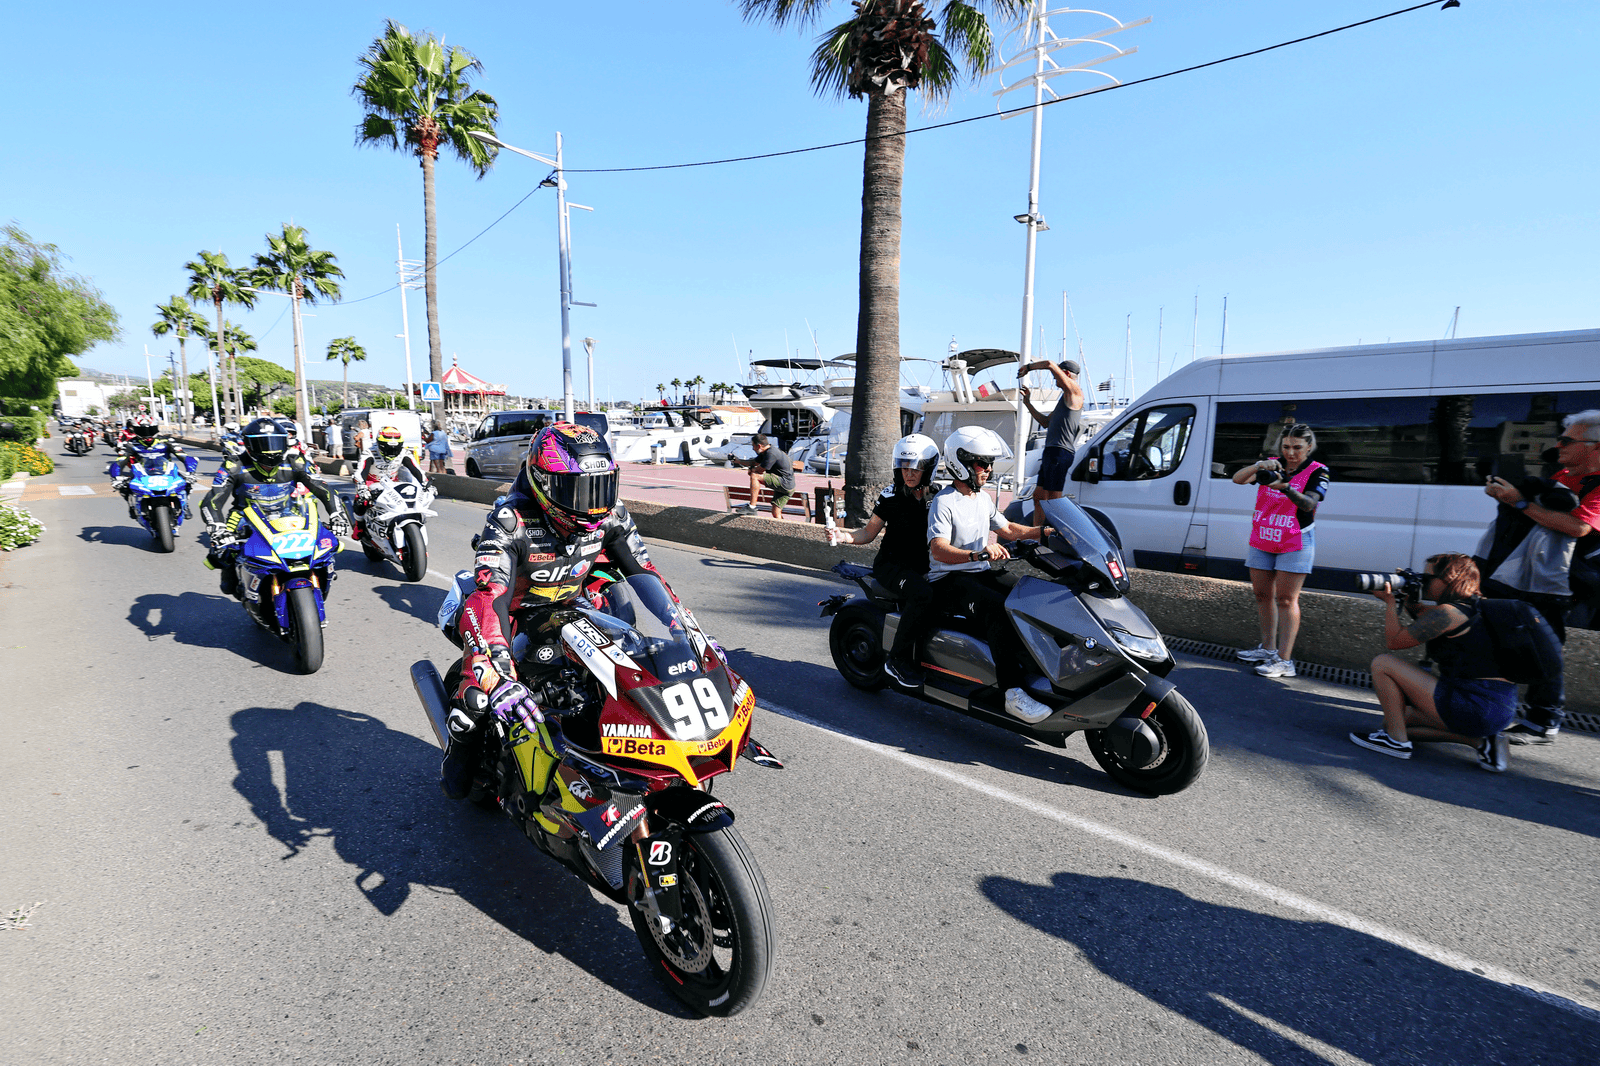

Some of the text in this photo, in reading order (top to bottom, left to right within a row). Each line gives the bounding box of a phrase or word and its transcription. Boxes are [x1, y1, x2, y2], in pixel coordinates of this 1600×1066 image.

[584, 460, 607, 470] SHOEI
[147, 476, 169, 488] 96
[400, 485, 417, 497] 4
[1259, 526, 1283, 542] 099
[273, 533, 316, 555] 222
[530, 564, 572, 582] elf
[577, 638, 596, 658] DTS
[668, 661, 689, 676] elf
[661, 677, 730, 741] 99
[740, 693, 756, 718] Beta
[602, 723, 653, 738] YAMAHA
[624, 740, 666, 756] Beta
[706, 738, 726, 751] Beta
